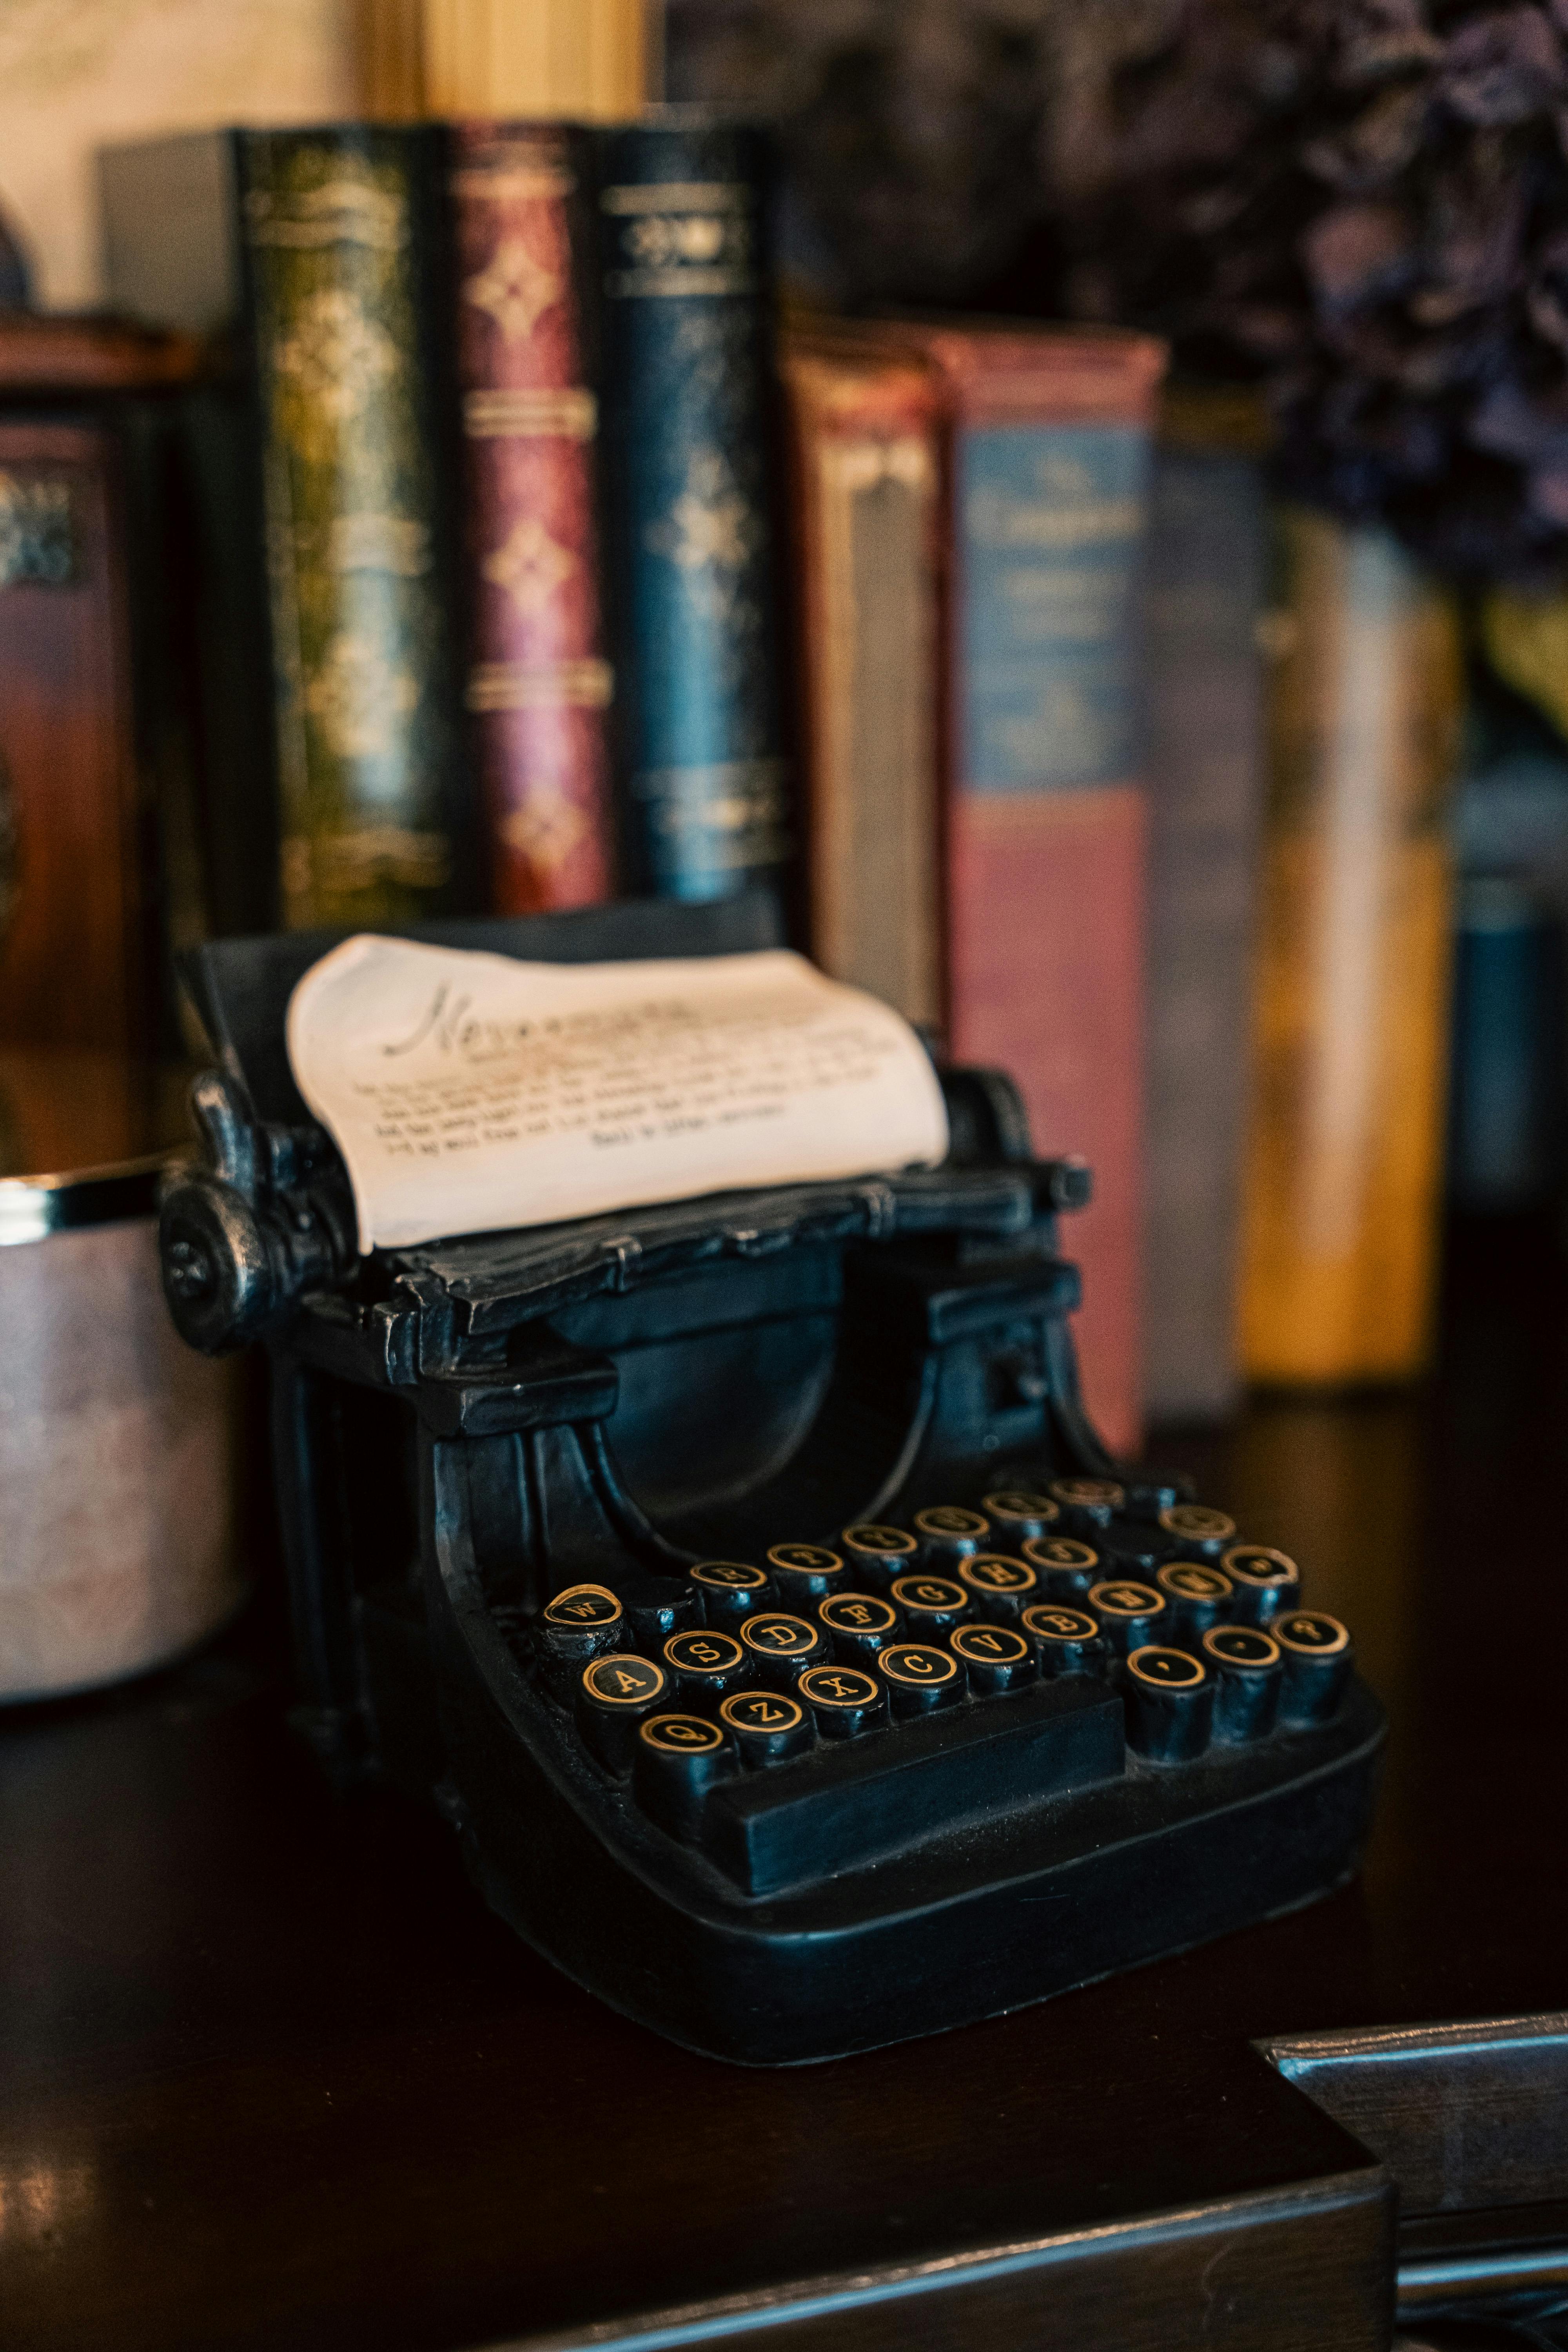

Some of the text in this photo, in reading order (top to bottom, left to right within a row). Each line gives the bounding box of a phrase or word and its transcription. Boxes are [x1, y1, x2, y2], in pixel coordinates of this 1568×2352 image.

[791, 1551, 823, 1565] T
[711, 1568, 749, 1581] R
[980, 1563, 1019, 1585] H
[916, 1584, 949, 1602] G
[564, 1602, 596, 1617] W
[840, 1604, 873, 1625] F
[1042, 1614, 1079, 1632] B
[761, 1625, 797, 1646] D
[970, 1634, 1003, 1652] V
[689, 1642, 721, 1663] S
[904, 1654, 933, 1673] C
[615, 1670, 646, 1693] A
[818, 1677, 859, 1697] X
[749, 1701, 784, 1722] Z
[664, 1725, 708, 1742] Q
